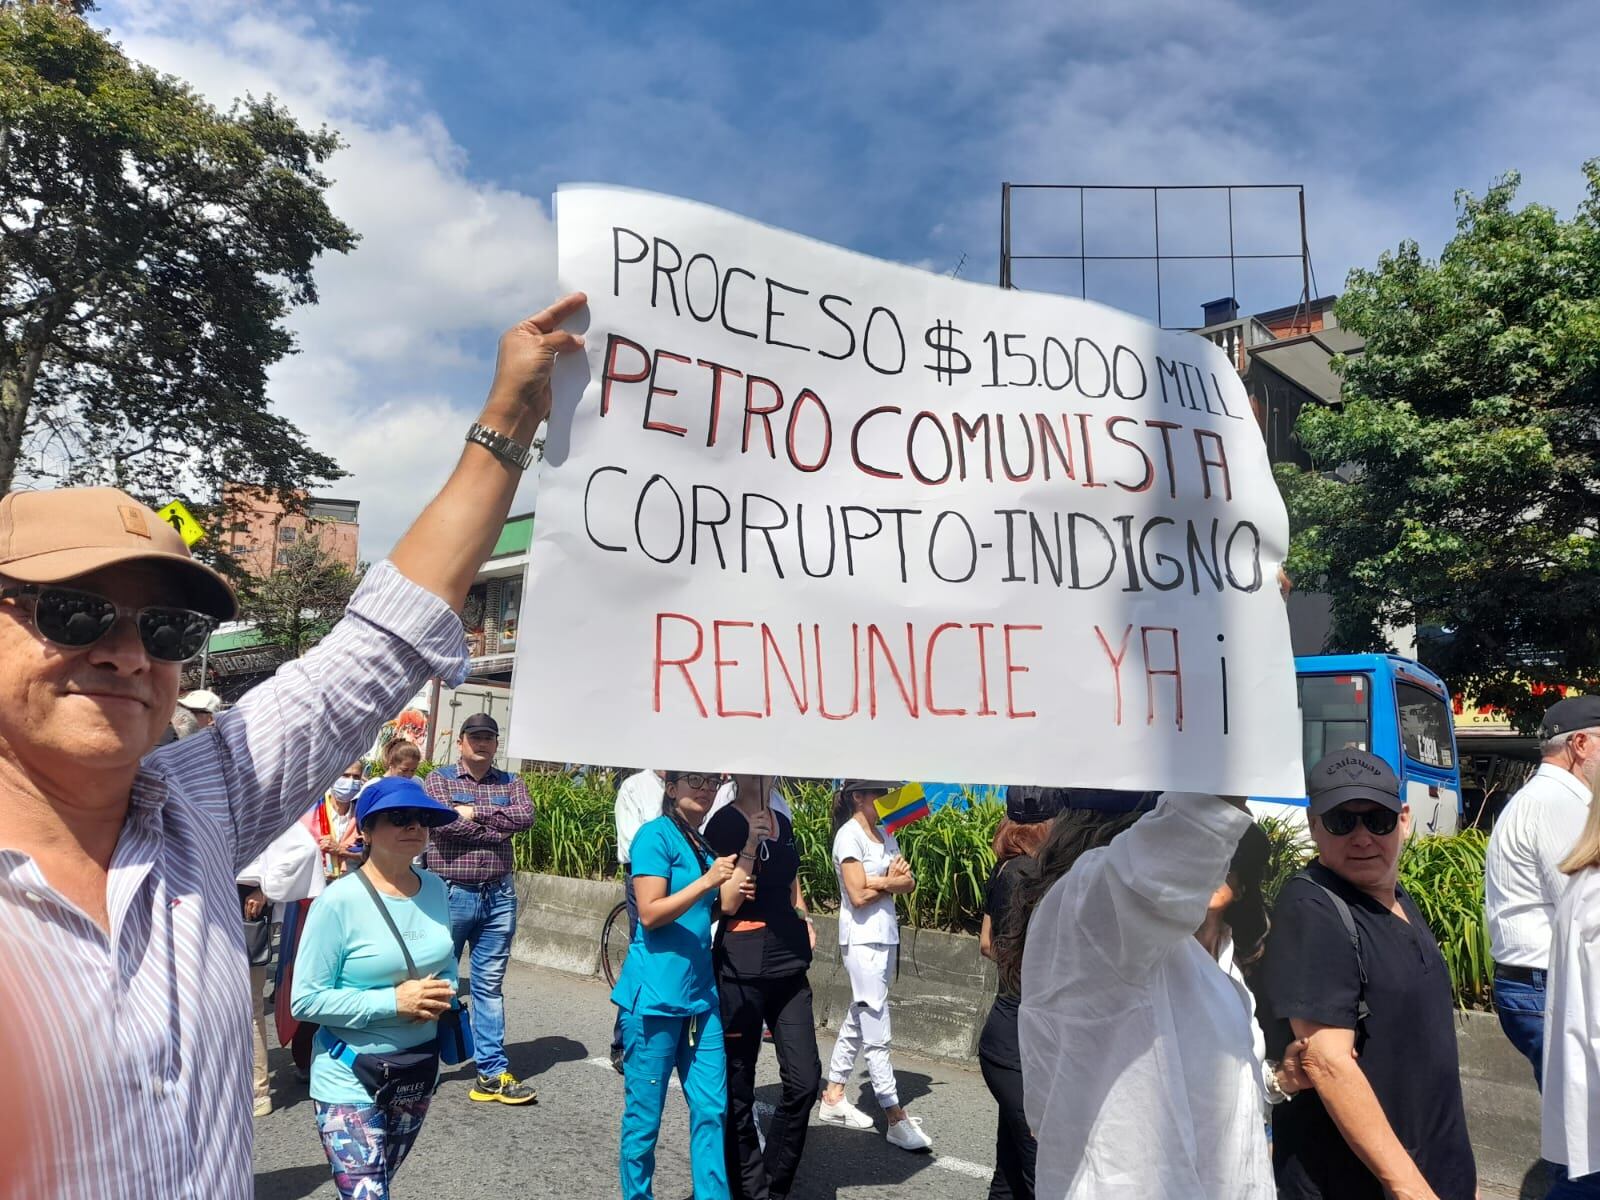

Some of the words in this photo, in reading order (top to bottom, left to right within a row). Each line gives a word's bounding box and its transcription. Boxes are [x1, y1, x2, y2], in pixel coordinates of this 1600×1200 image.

[612, 226, 906, 375] PROCESO
[1155, 355, 1244, 420] MILL
[599, 333, 833, 473] PETRO
[850, 405, 1233, 502] COMUNISTA
[652, 612, 1043, 720] RENUNCIE
[1094, 622, 1183, 733] YA
[1326, 757, 1382, 776] Callaway
